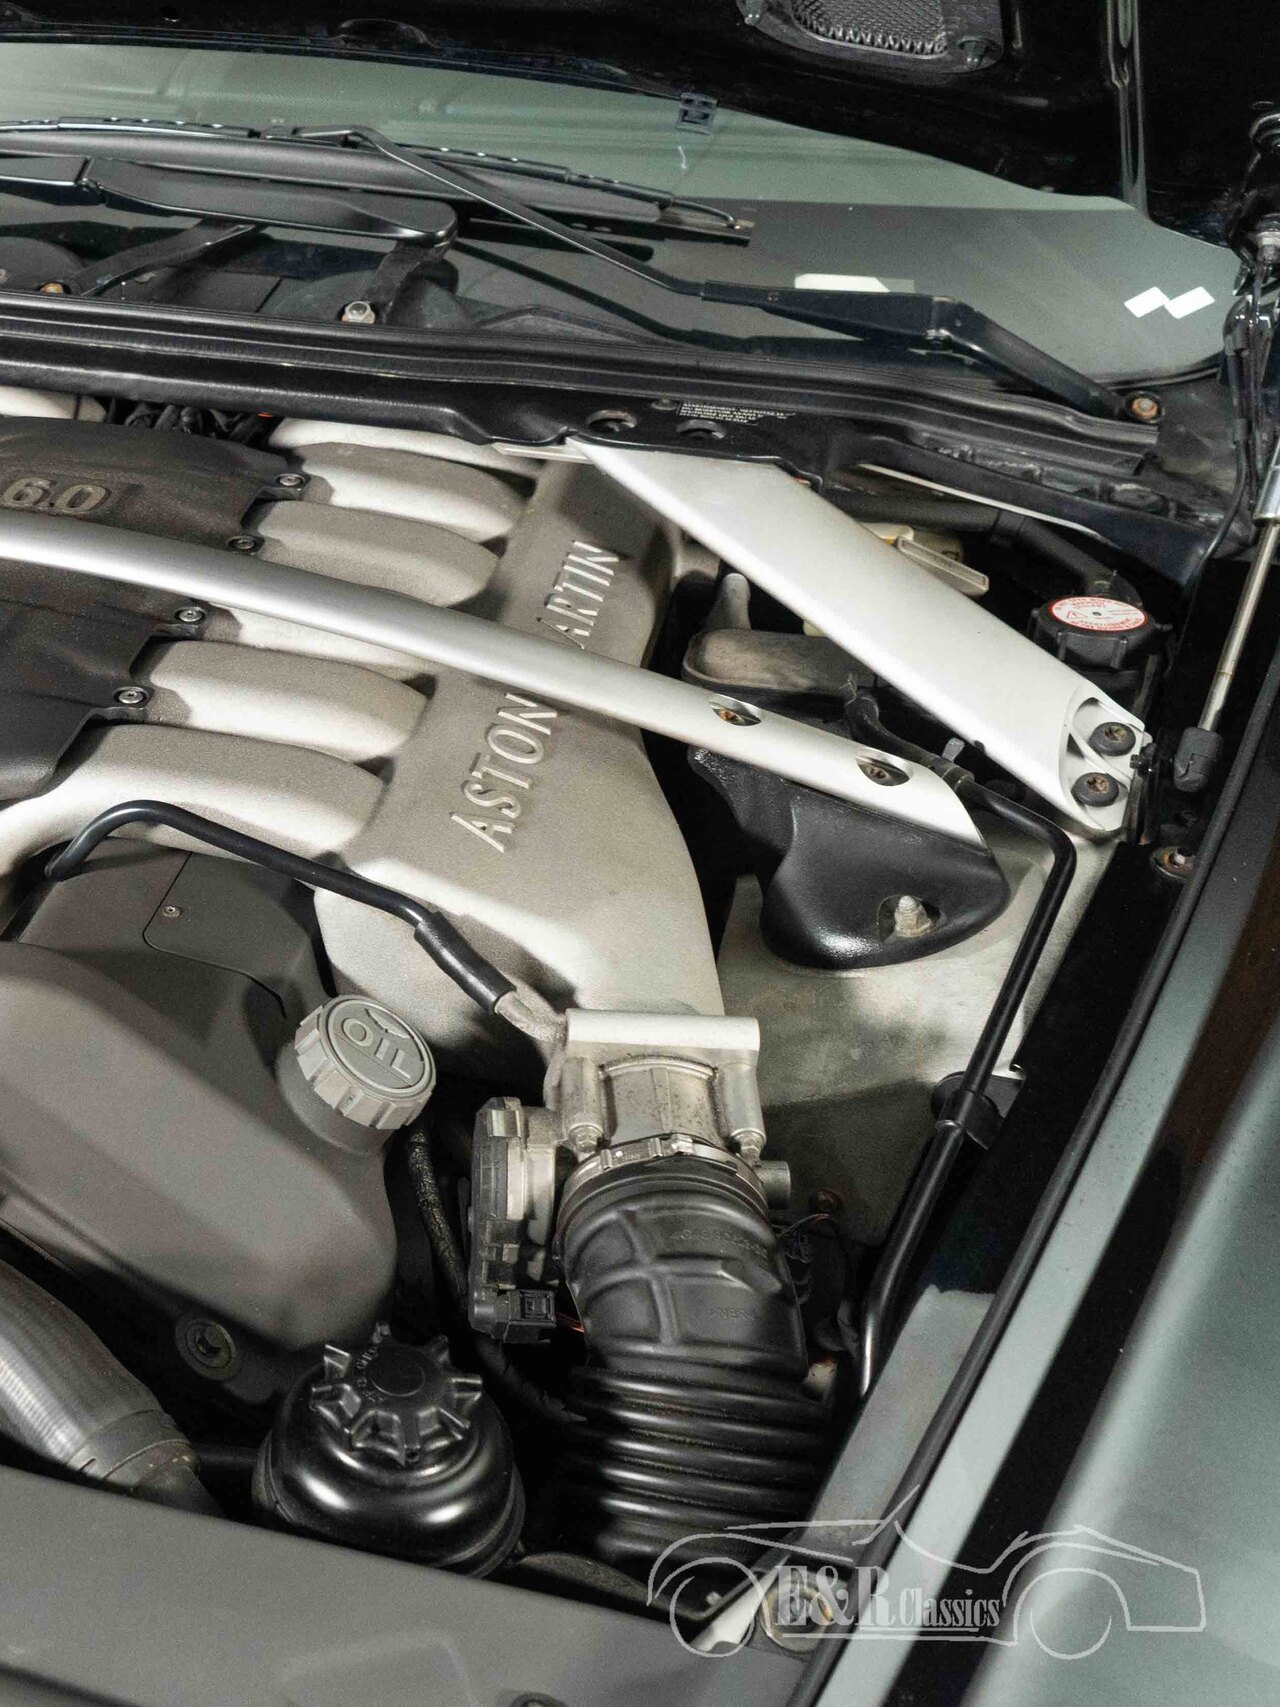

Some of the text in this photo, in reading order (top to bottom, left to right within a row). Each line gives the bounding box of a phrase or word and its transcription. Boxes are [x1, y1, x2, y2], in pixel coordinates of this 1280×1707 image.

[2, 477, 110, 514] 6.0
[537, 539, 619, 649] ARTIN
[450, 692, 558, 853] ASTON
[341, 1018, 412, 1079] OIL
